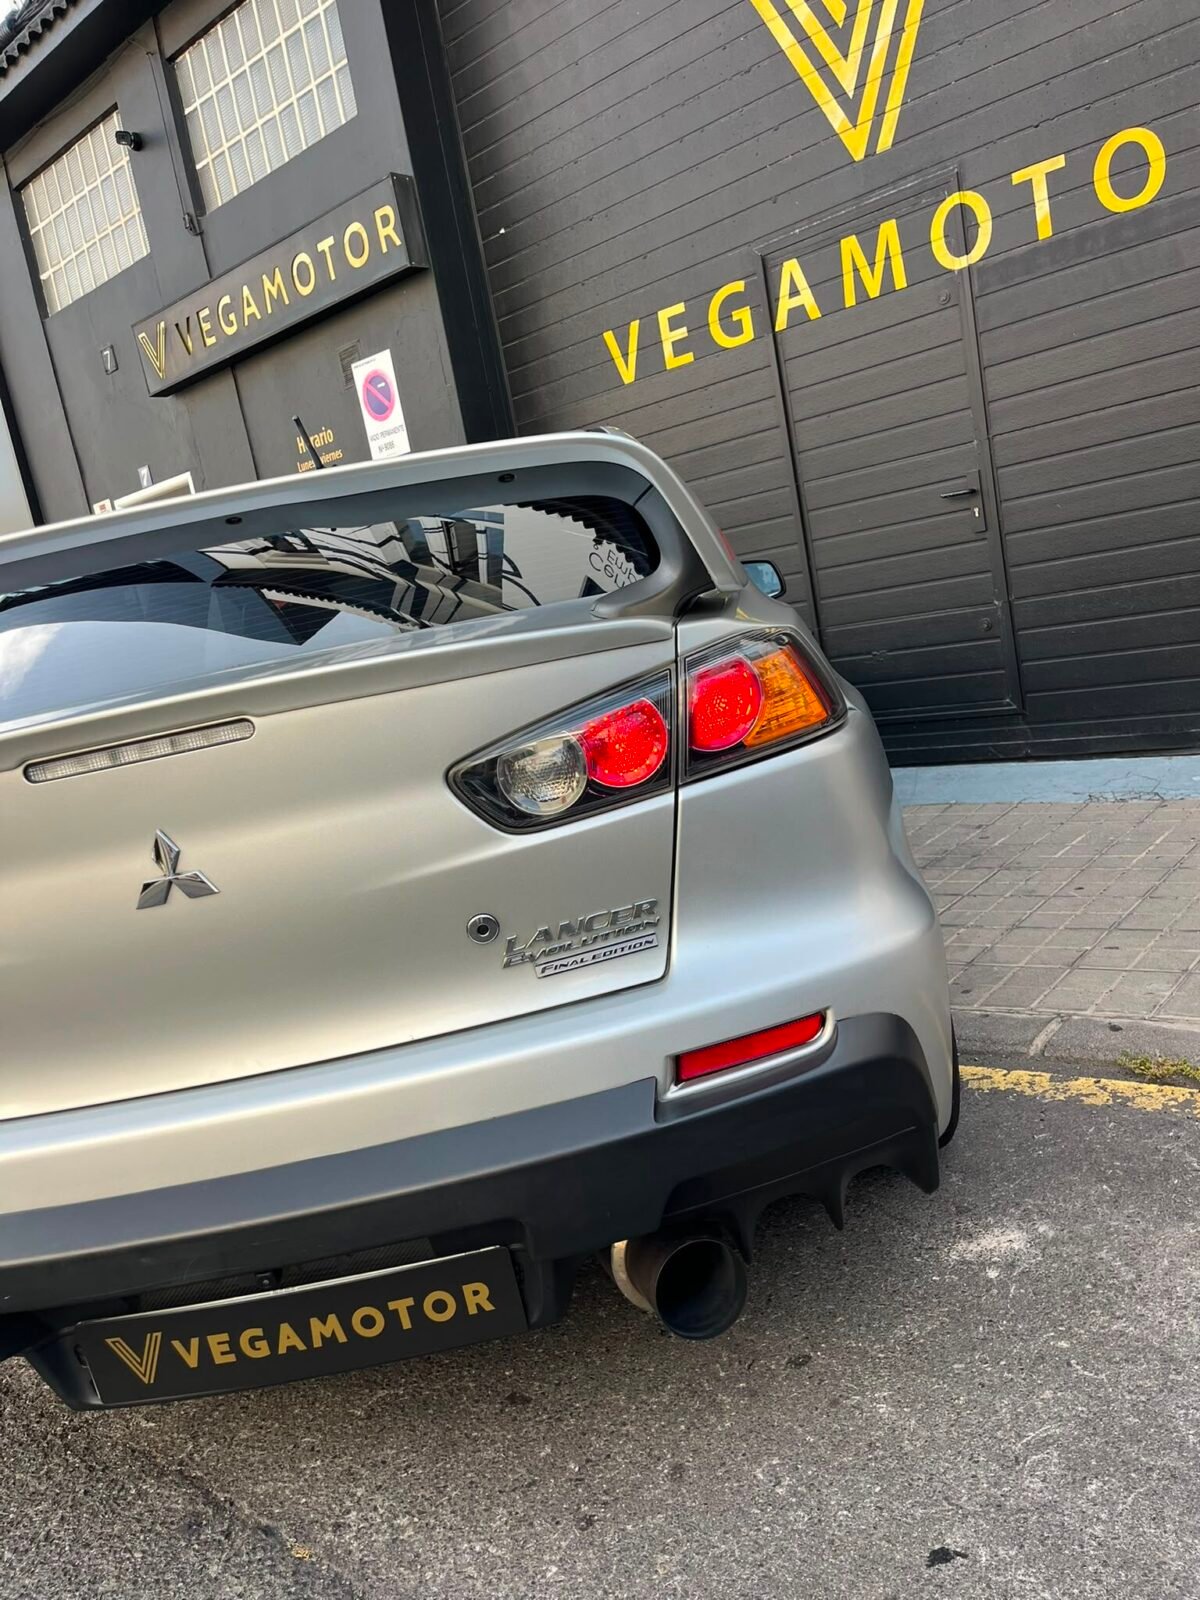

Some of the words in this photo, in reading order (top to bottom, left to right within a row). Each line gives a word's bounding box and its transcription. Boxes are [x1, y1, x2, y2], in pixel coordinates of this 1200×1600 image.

[175, 204, 402, 355] VEGAMOTOR
[602, 127, 1167, 385] VEGAMOTO
[296, 426, 334, 454] Hrario
[502, 915, 660, 969] EVOLUTION
[504, 898, 658, 953] LANCER
[540, 955, 590, 974] FINAL
[590, 938, 655, 961] EDITION
[171, 1281, 496, 1368] VEGAMOTOR
